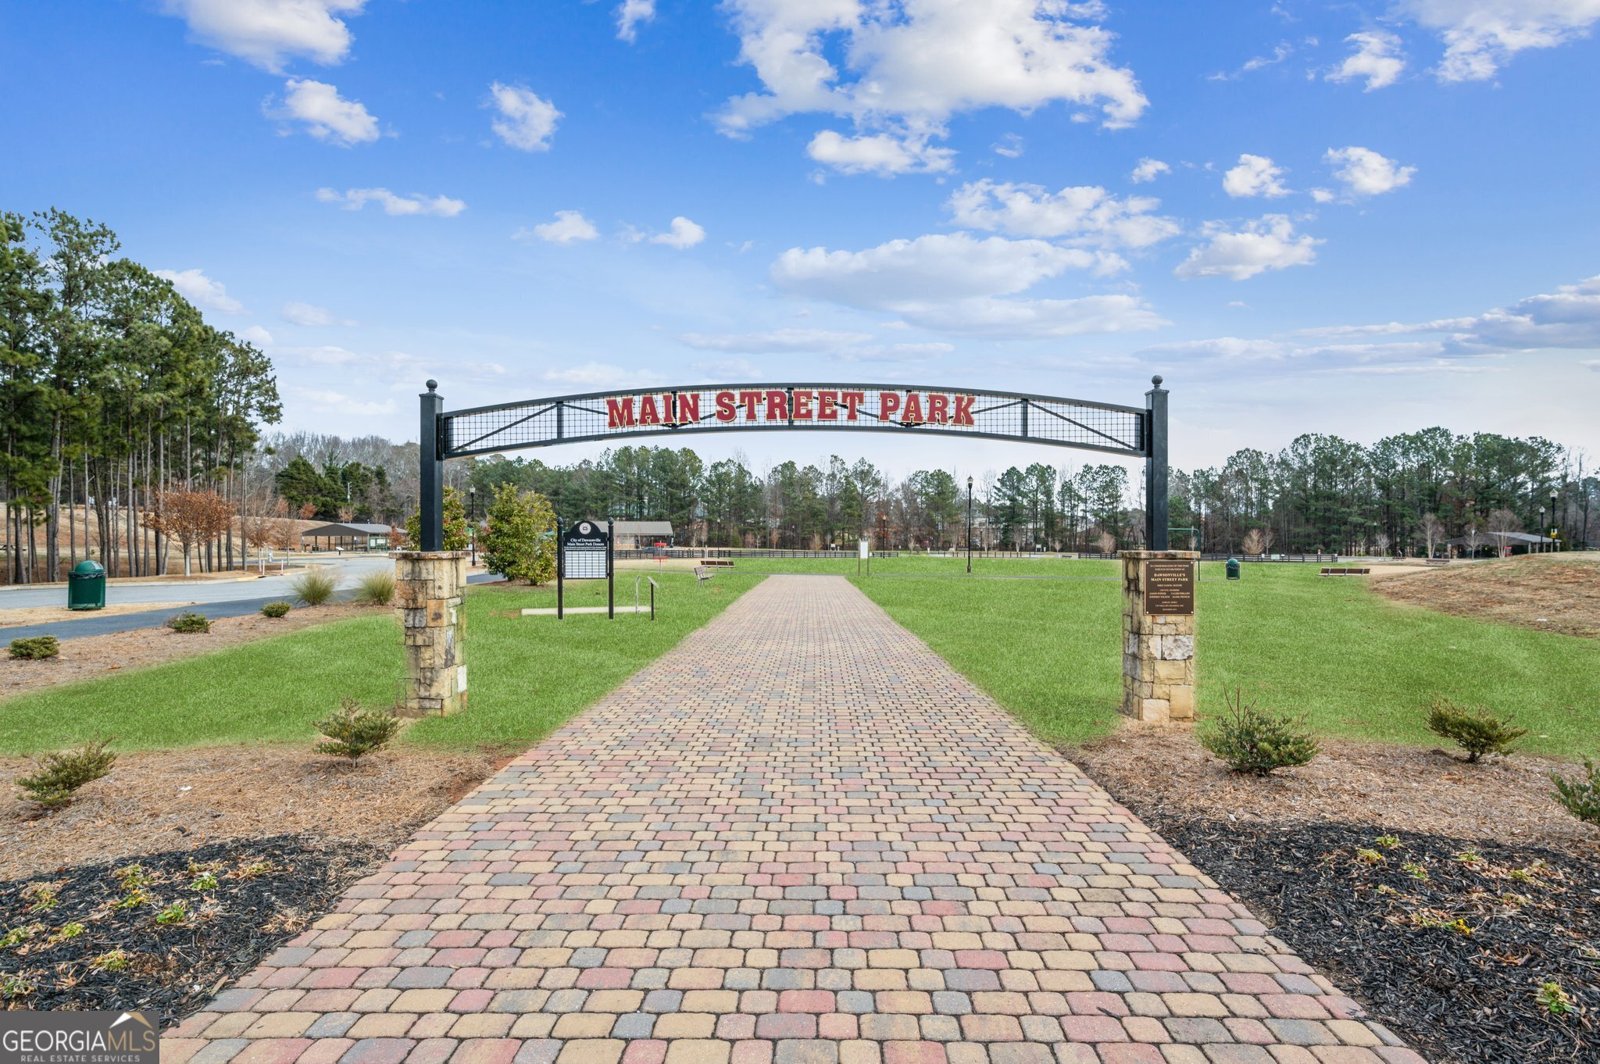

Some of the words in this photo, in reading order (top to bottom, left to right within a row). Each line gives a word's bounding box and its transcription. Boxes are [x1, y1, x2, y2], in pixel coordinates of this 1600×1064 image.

[606, 391, 700, 428] MAIN
[714, 390, 864, 423] STREET
[878, 392, 976, 426] PARK
